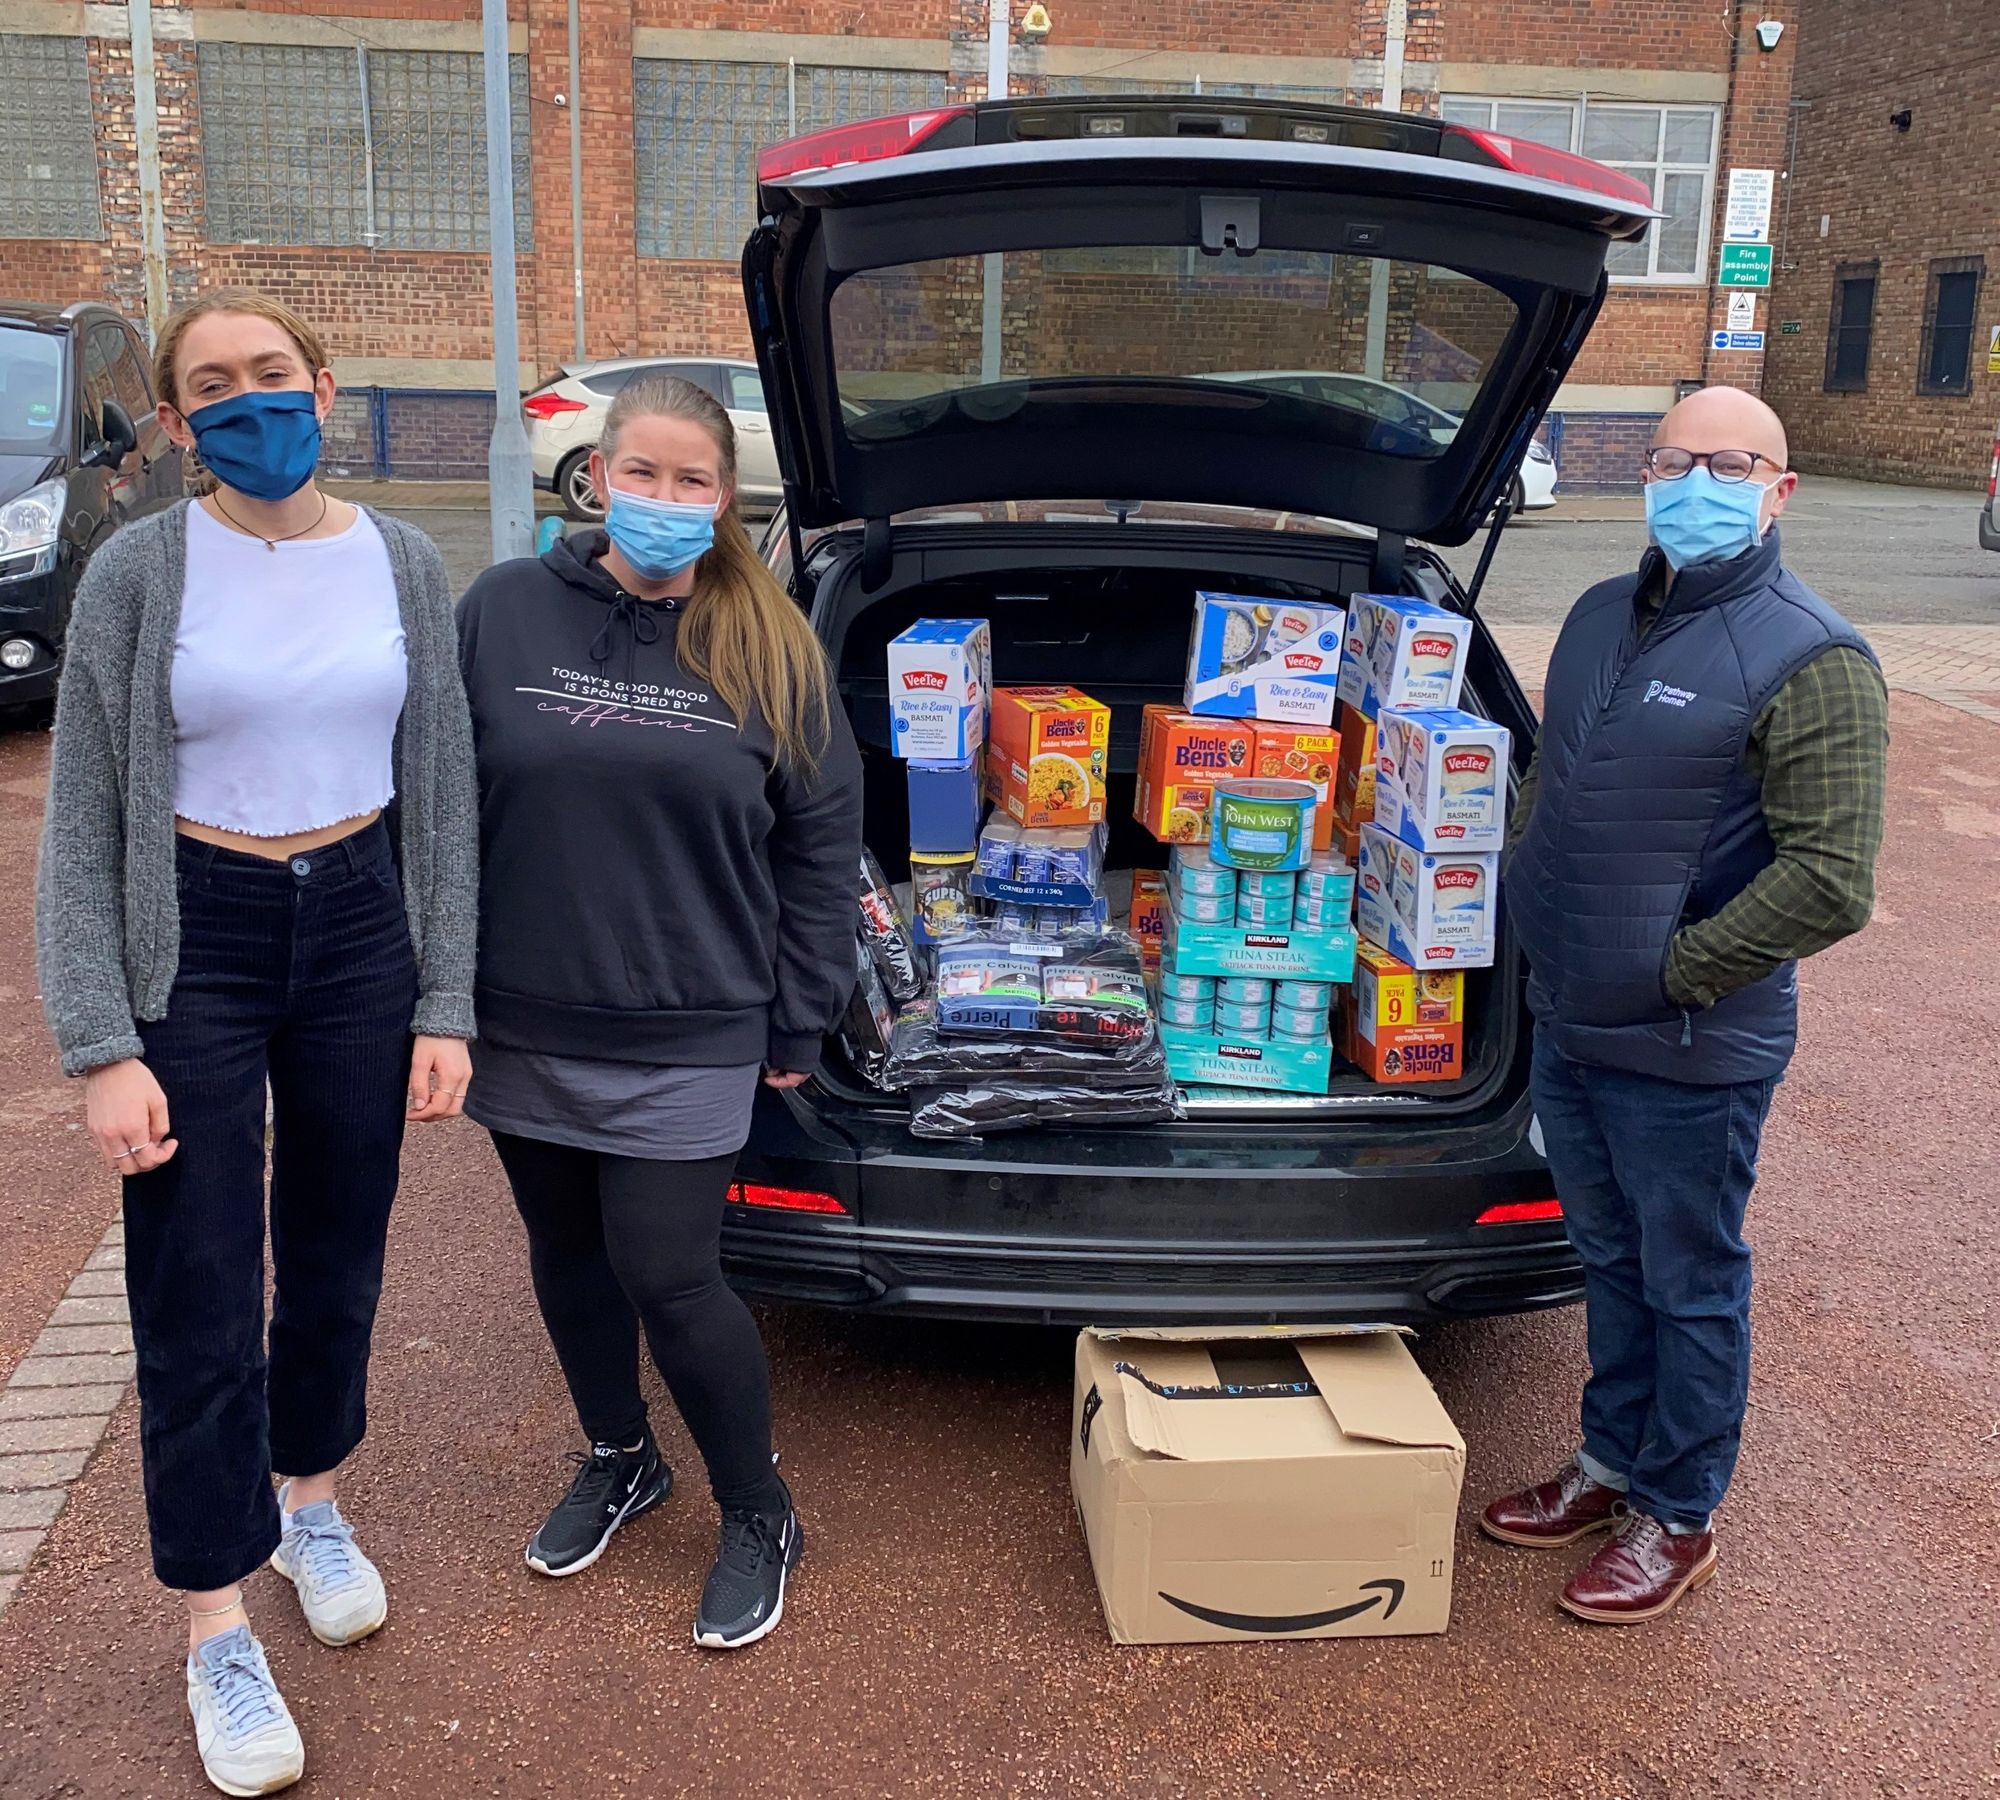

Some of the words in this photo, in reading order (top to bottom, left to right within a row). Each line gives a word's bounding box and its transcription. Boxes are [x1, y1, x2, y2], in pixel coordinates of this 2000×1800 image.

[1739, 249, 1757, 259] Fire
[1724, 261, 1769, 272] assembly
[1734, 272, 1758, 283] Point
[1324, 634, 1332, 646] 2
[951, 648, 957, 657] 6
[1414, 641, 1449, 656] VeeTee
[1286, 655, 1321, 670] VeeTee
[551, 666, 610, 689] TODAY'S
[905, 673, 945, 688] VeeTee
[615, 682, 659, 695] GOOD
[664, 687, 708, 704] MOOD
[1230, 680, 1239, 693] 6
[564, 682, 578, 692] IS
[582, 685, 668, 708] SPONSORED
[673, 700, 691, 711] BY
[1270, 683, 1291, 696] Rice
[1292, 687, 1301, 697] &
[1301, 687, 1328, 704] Easy
[1408, 691, 1439, 700] BASMATI
[1658, 693, 1686, 707] Homes
[1662, 685, 1697, 702] Pathway
[900, 700, 920, 712] Rice
[921, 702, 929, 710] &
[929, 701, 953, 715] Easy
[1279, 700, 1316, 710] BASMATI
[537, 702, 707, 733] caffeine
[1053, 718, 1076, 728] Uncle
[898, 720, 905, 729] 2
[1095, 716, 1104, 733] 6
[1040, 740, 1060, 748] Golden
[1061, 739, 1089, 747] Vegetable
[1188, 736, 1227, 751] Uncle
[1297, 737, 1305, 749] 6
[1307, 738, 1328, 748] PACK
[1447, 756, 1486, 771] VeeTee
[1183, 769, 1204, 778] Golden
[1205, 769, 1234, 778] Vegetable
[1092, 803, 1098, 812] 6
[1225, 804, 1256, 825] JOHN
[1259, 813, 1294, 827] WEST
[1436, 827, 1463, 837] VeeTee
[1436, 873, 1475, 887] VeeTee
[925, 886, 965, 904] SUPER
[998, 883, 1023, 894] CORNED
[1036, 887, 1043, 895] 12
[1049, 888, 1063, 896] 340g
[1437, 926, 1470, 935] BASMATI
[1246, 935, 1289, 945] KIRKLAND
[1227, 950, 1263, 961] TUNA
[1266, 951, 1305, 963] STEAK
[1426, 947, 1453, 959] VeeTee
[942, 962, 982, 971] Pierre
[987, 961, 1035, 972] Calvini
[1220, 962, 1254, 970] SKIPJACK
[1255, 963, 1276, 971] TUNA
[1287, 964, 1311, 973] BRINE
[1016, 973, 1026, 982] 3
[1091, 969, 1140, 984] Calvini
[1121, 983, 1131, 992] 3
[1386, 989, 1405, 997] PACK
[1388, 998, 1402, 1023] 6
[951, 1011, 1010, 1028] Pierre
[1394, 1034, 1424, 1042] Vegetable
[1424, 1033, 1445, 1041] Golden
[1220, 1046, 1262, 1056] KIRKLAND
[1200, 1057, 1237, 1071] TUNA
[1239, 1062, 1280, 1076] STEAK
[1404, 1059, 1443, 1075] Uncle
[1194, 1069, 1227, 1080] SKIPJACK
[1229, 1073, 1250, 1082] TUNA
[1261, 1076, 1284, 1085] BRINE
